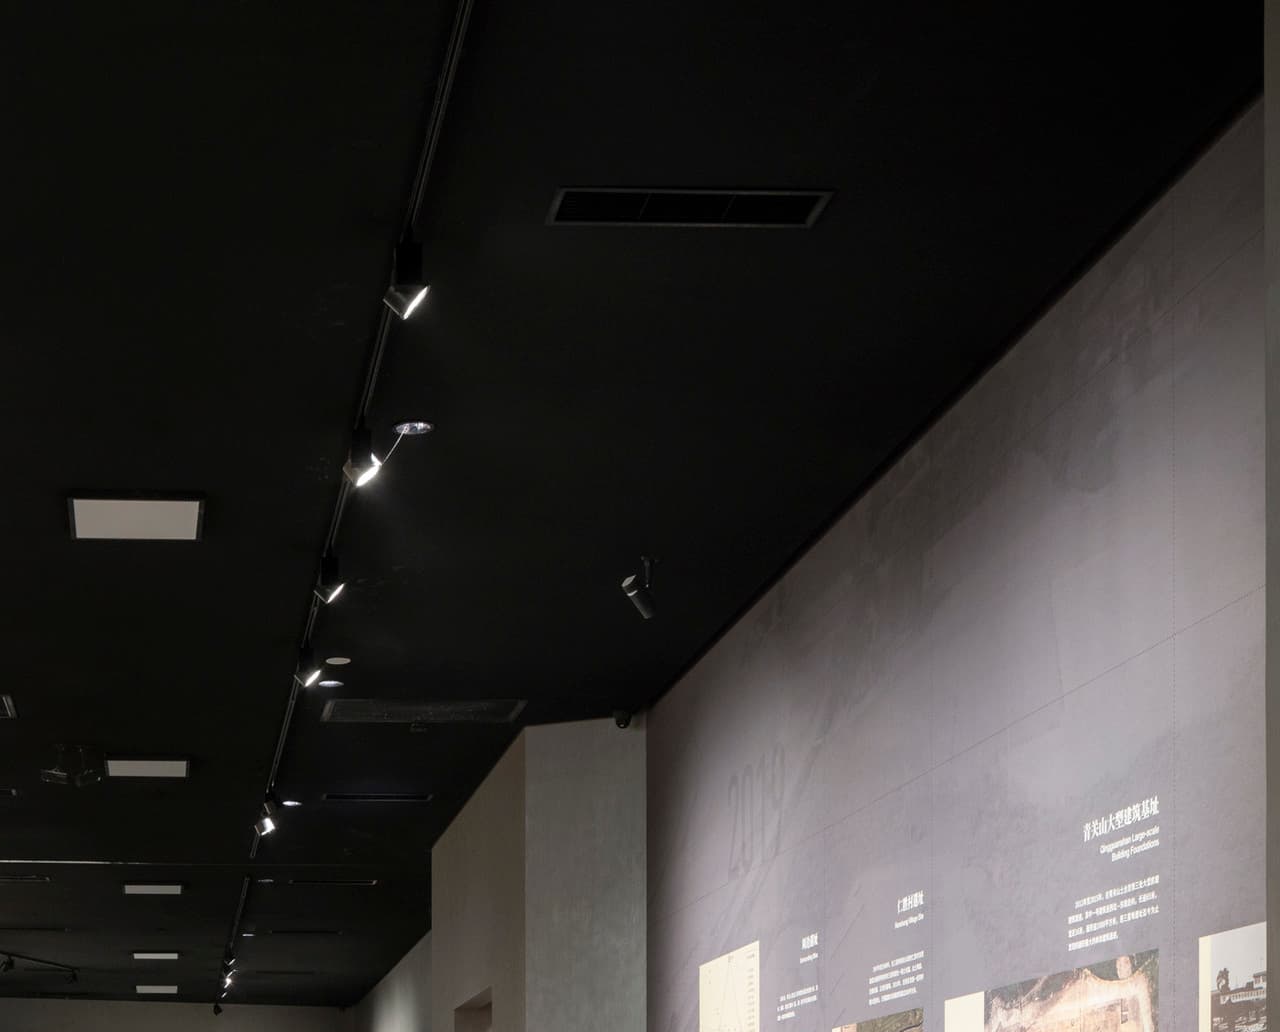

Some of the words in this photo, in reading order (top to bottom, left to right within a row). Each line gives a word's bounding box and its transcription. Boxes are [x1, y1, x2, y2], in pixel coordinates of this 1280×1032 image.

[1083, 795, 1160, 843] 青关山大型建筑基址
